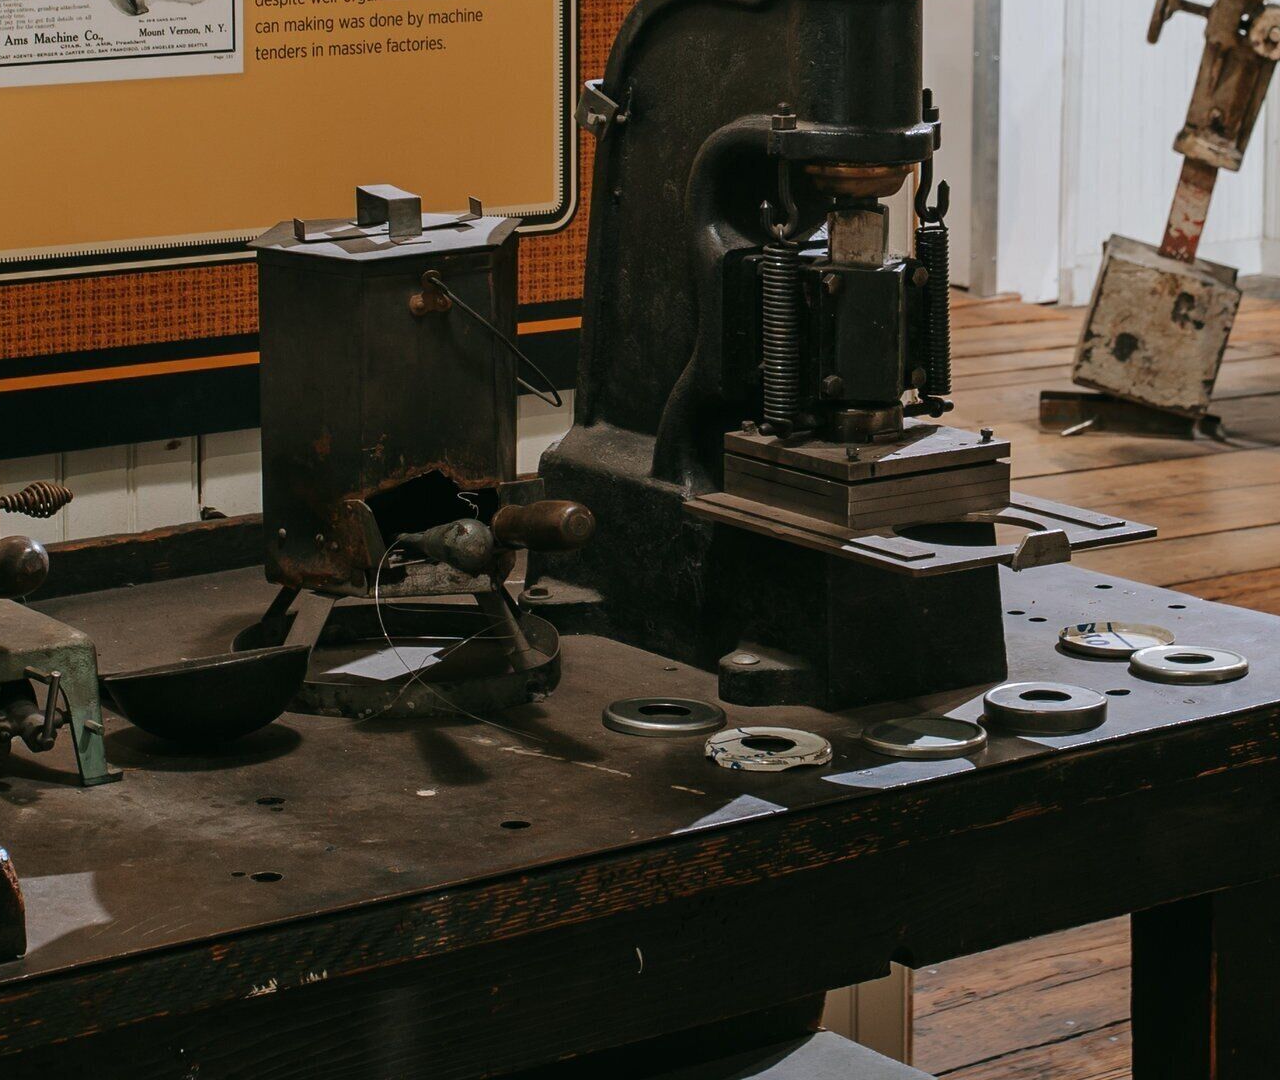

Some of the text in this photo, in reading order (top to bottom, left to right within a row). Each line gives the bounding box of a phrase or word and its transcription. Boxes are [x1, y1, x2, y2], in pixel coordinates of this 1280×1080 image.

[3, 33, 29, 47] Ams
[33, 30, 82, 44] Machine
[83, 28, 104, 42] Co.,
[138, 22, 227, 38] Mount Vernon, N. Y.
